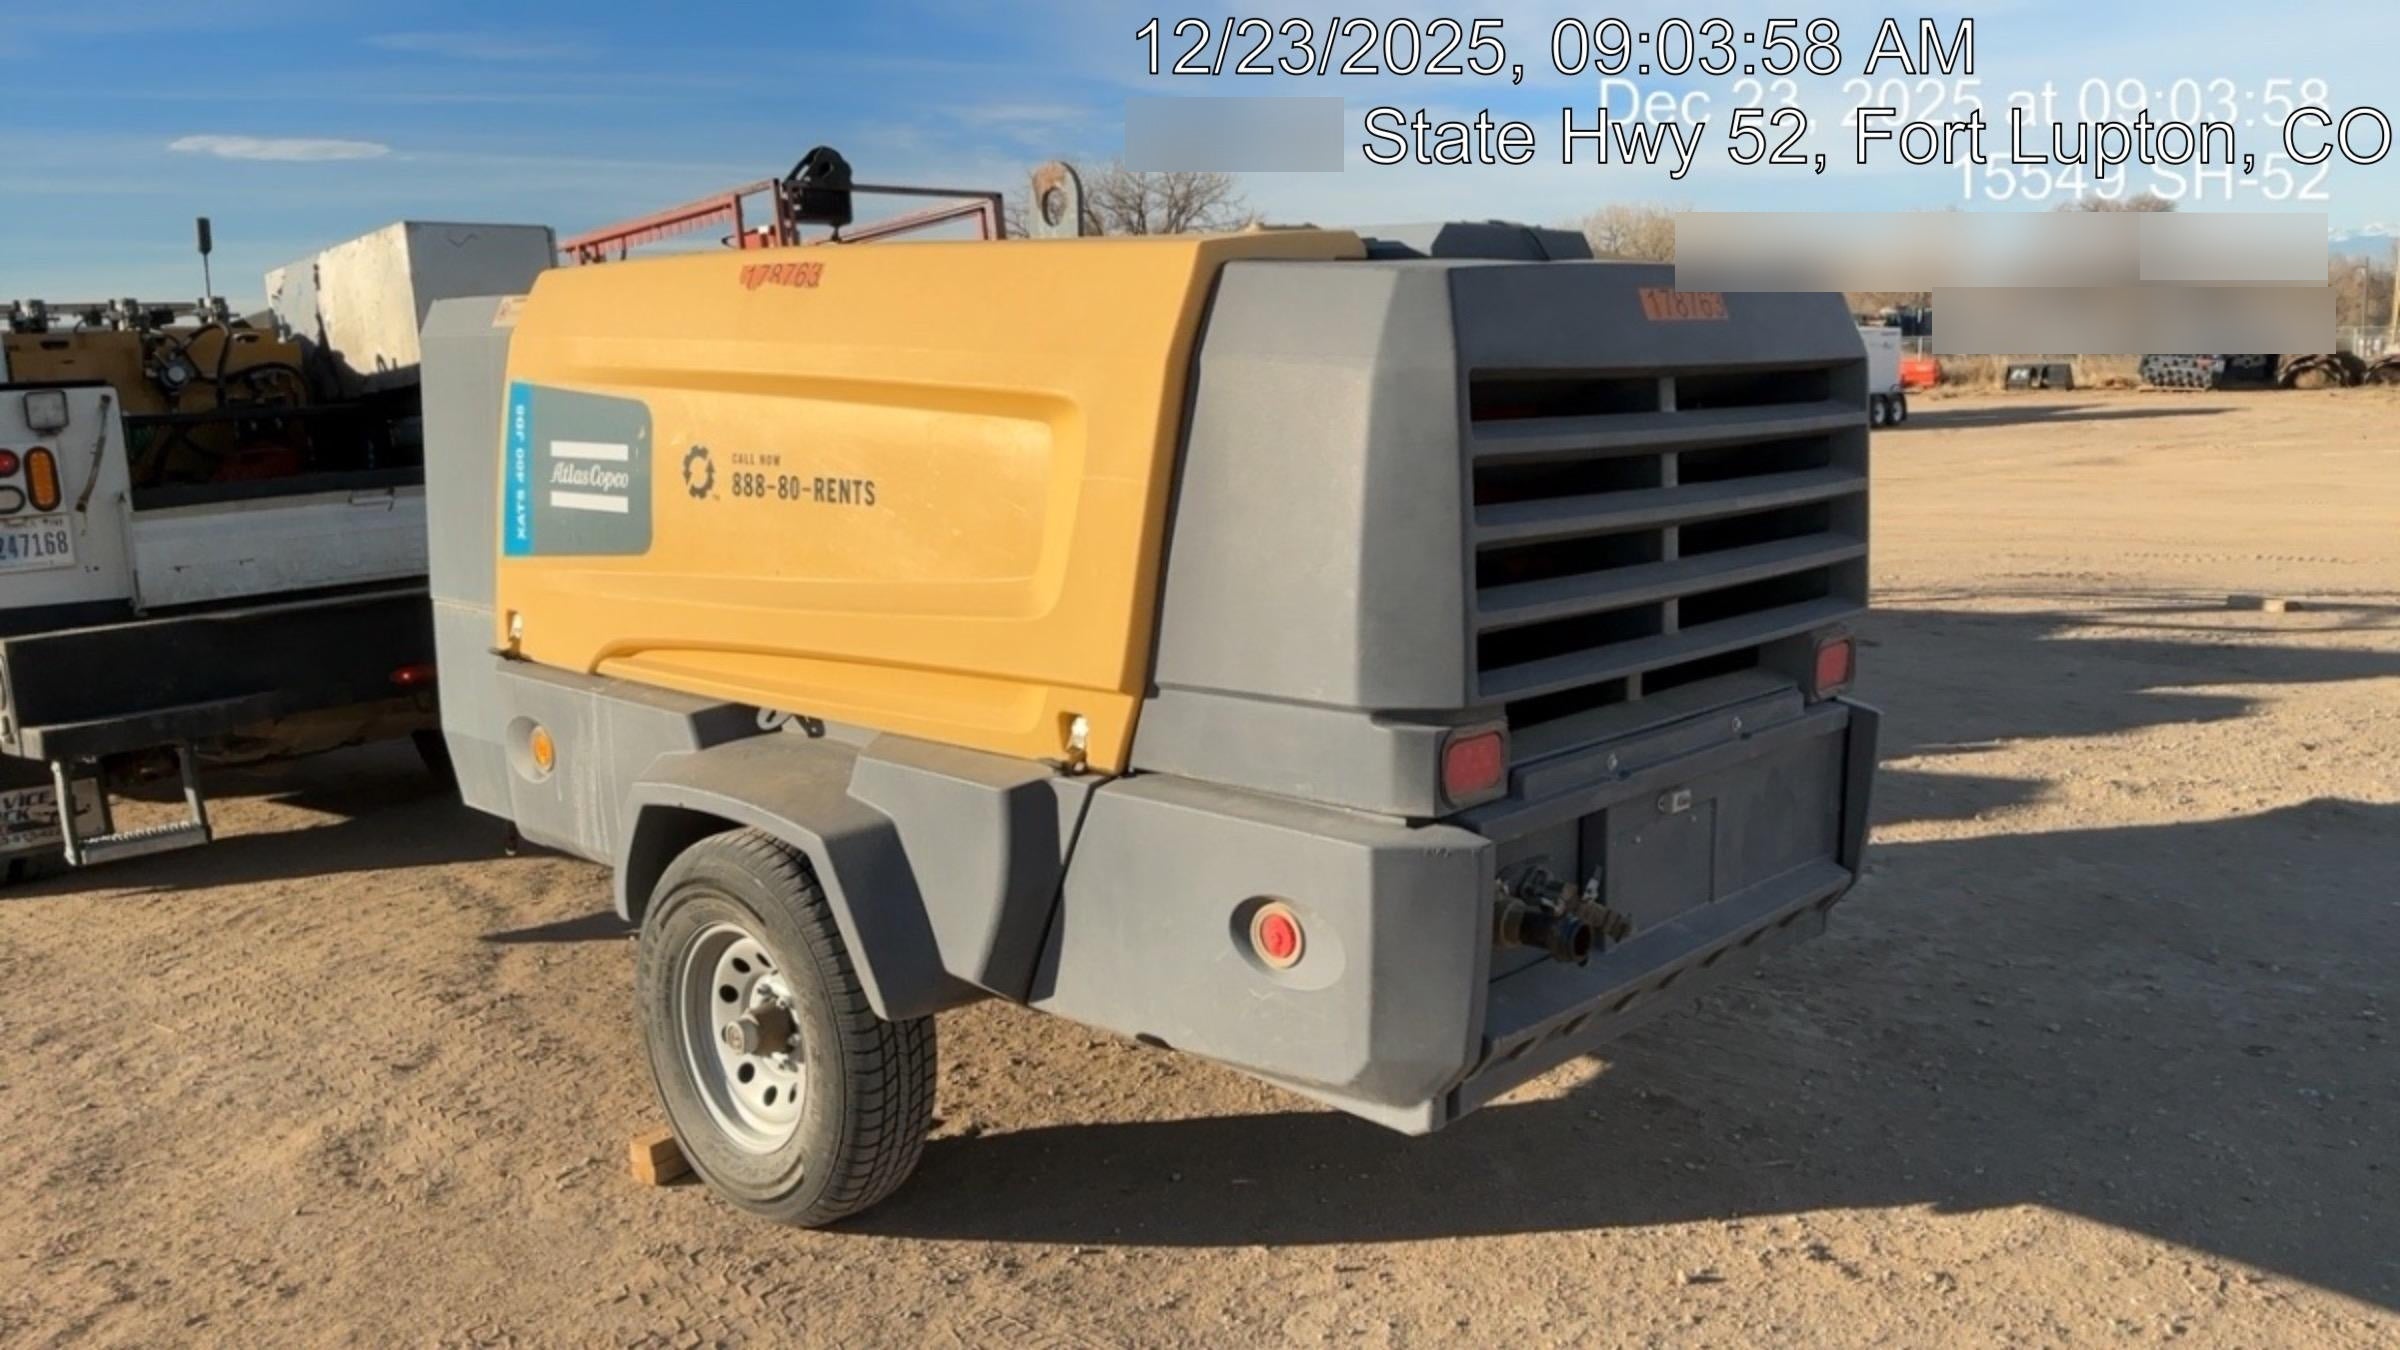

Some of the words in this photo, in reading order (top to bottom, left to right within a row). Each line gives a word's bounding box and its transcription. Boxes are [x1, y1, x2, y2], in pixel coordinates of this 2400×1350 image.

[514, 447, 527, 483] 400
[731, 452, 755, 466] CALL
[759, 453, 781, 467] NOW
[731, 471, 877, 507] 888-80-RENTS
[514, 488, 528, 540] XATS
